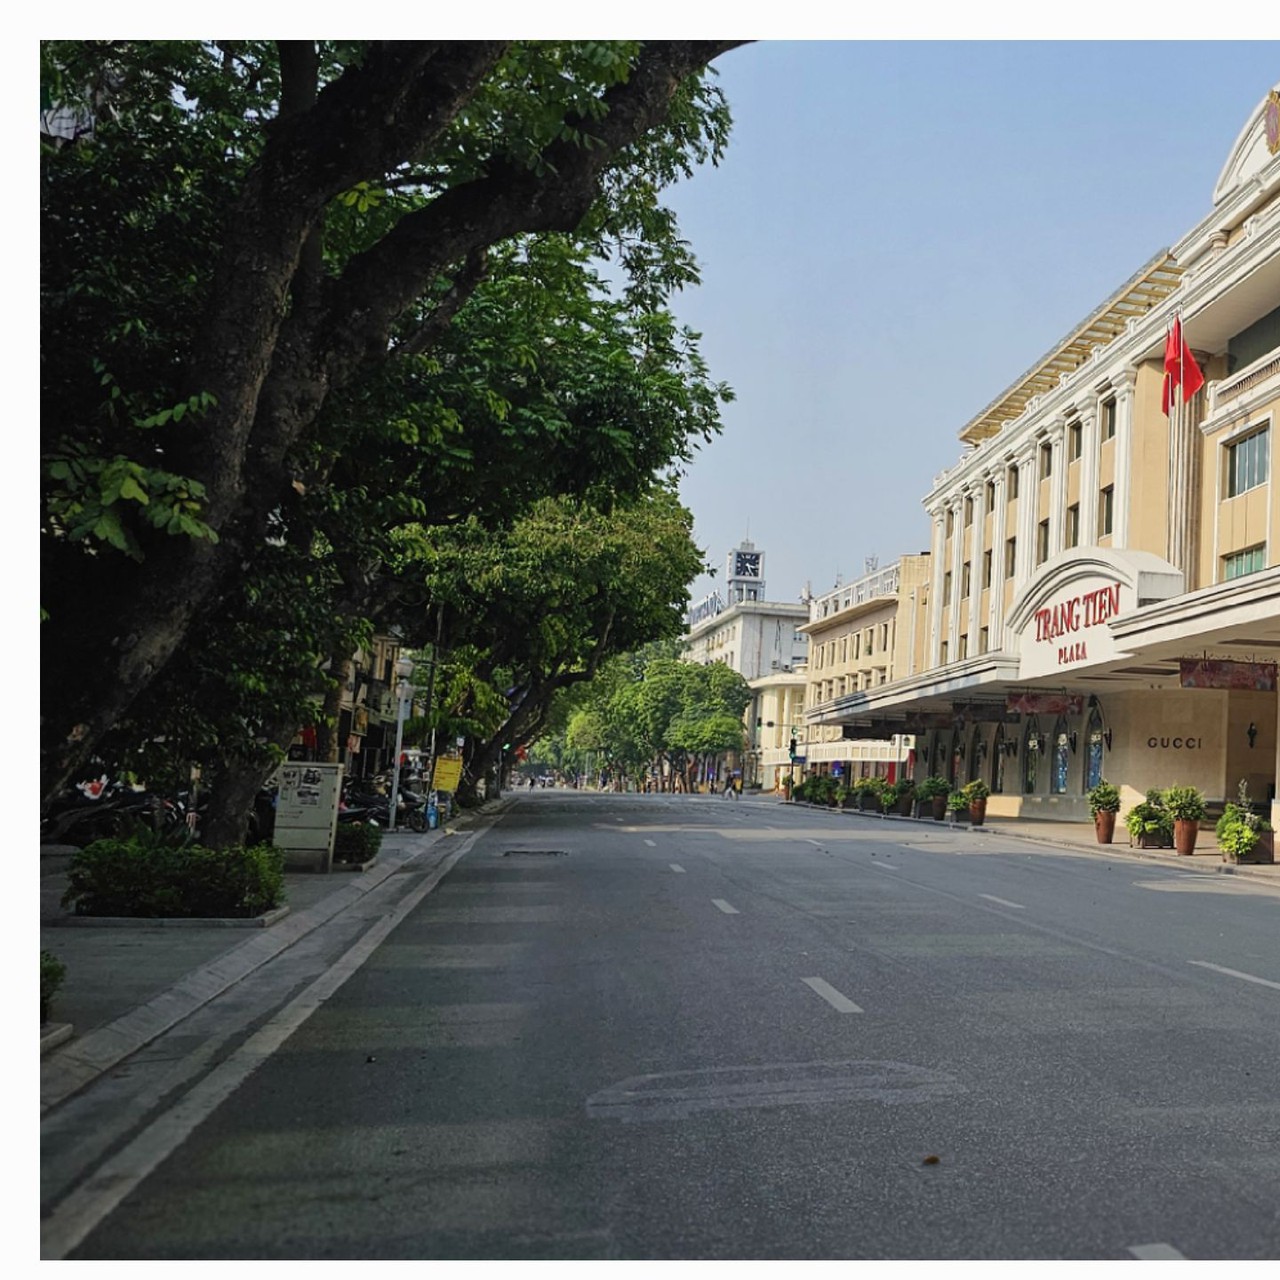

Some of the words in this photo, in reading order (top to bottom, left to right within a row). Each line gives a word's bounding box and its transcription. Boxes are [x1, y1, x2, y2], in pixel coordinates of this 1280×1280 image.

[1035, 597, 1080, 645] TRANG
[1083, 582, 1121, 628] TIEN
[1058, 641, 1087, 665] PLAZA
[1147, 737, 1202, 749] GUCCI
